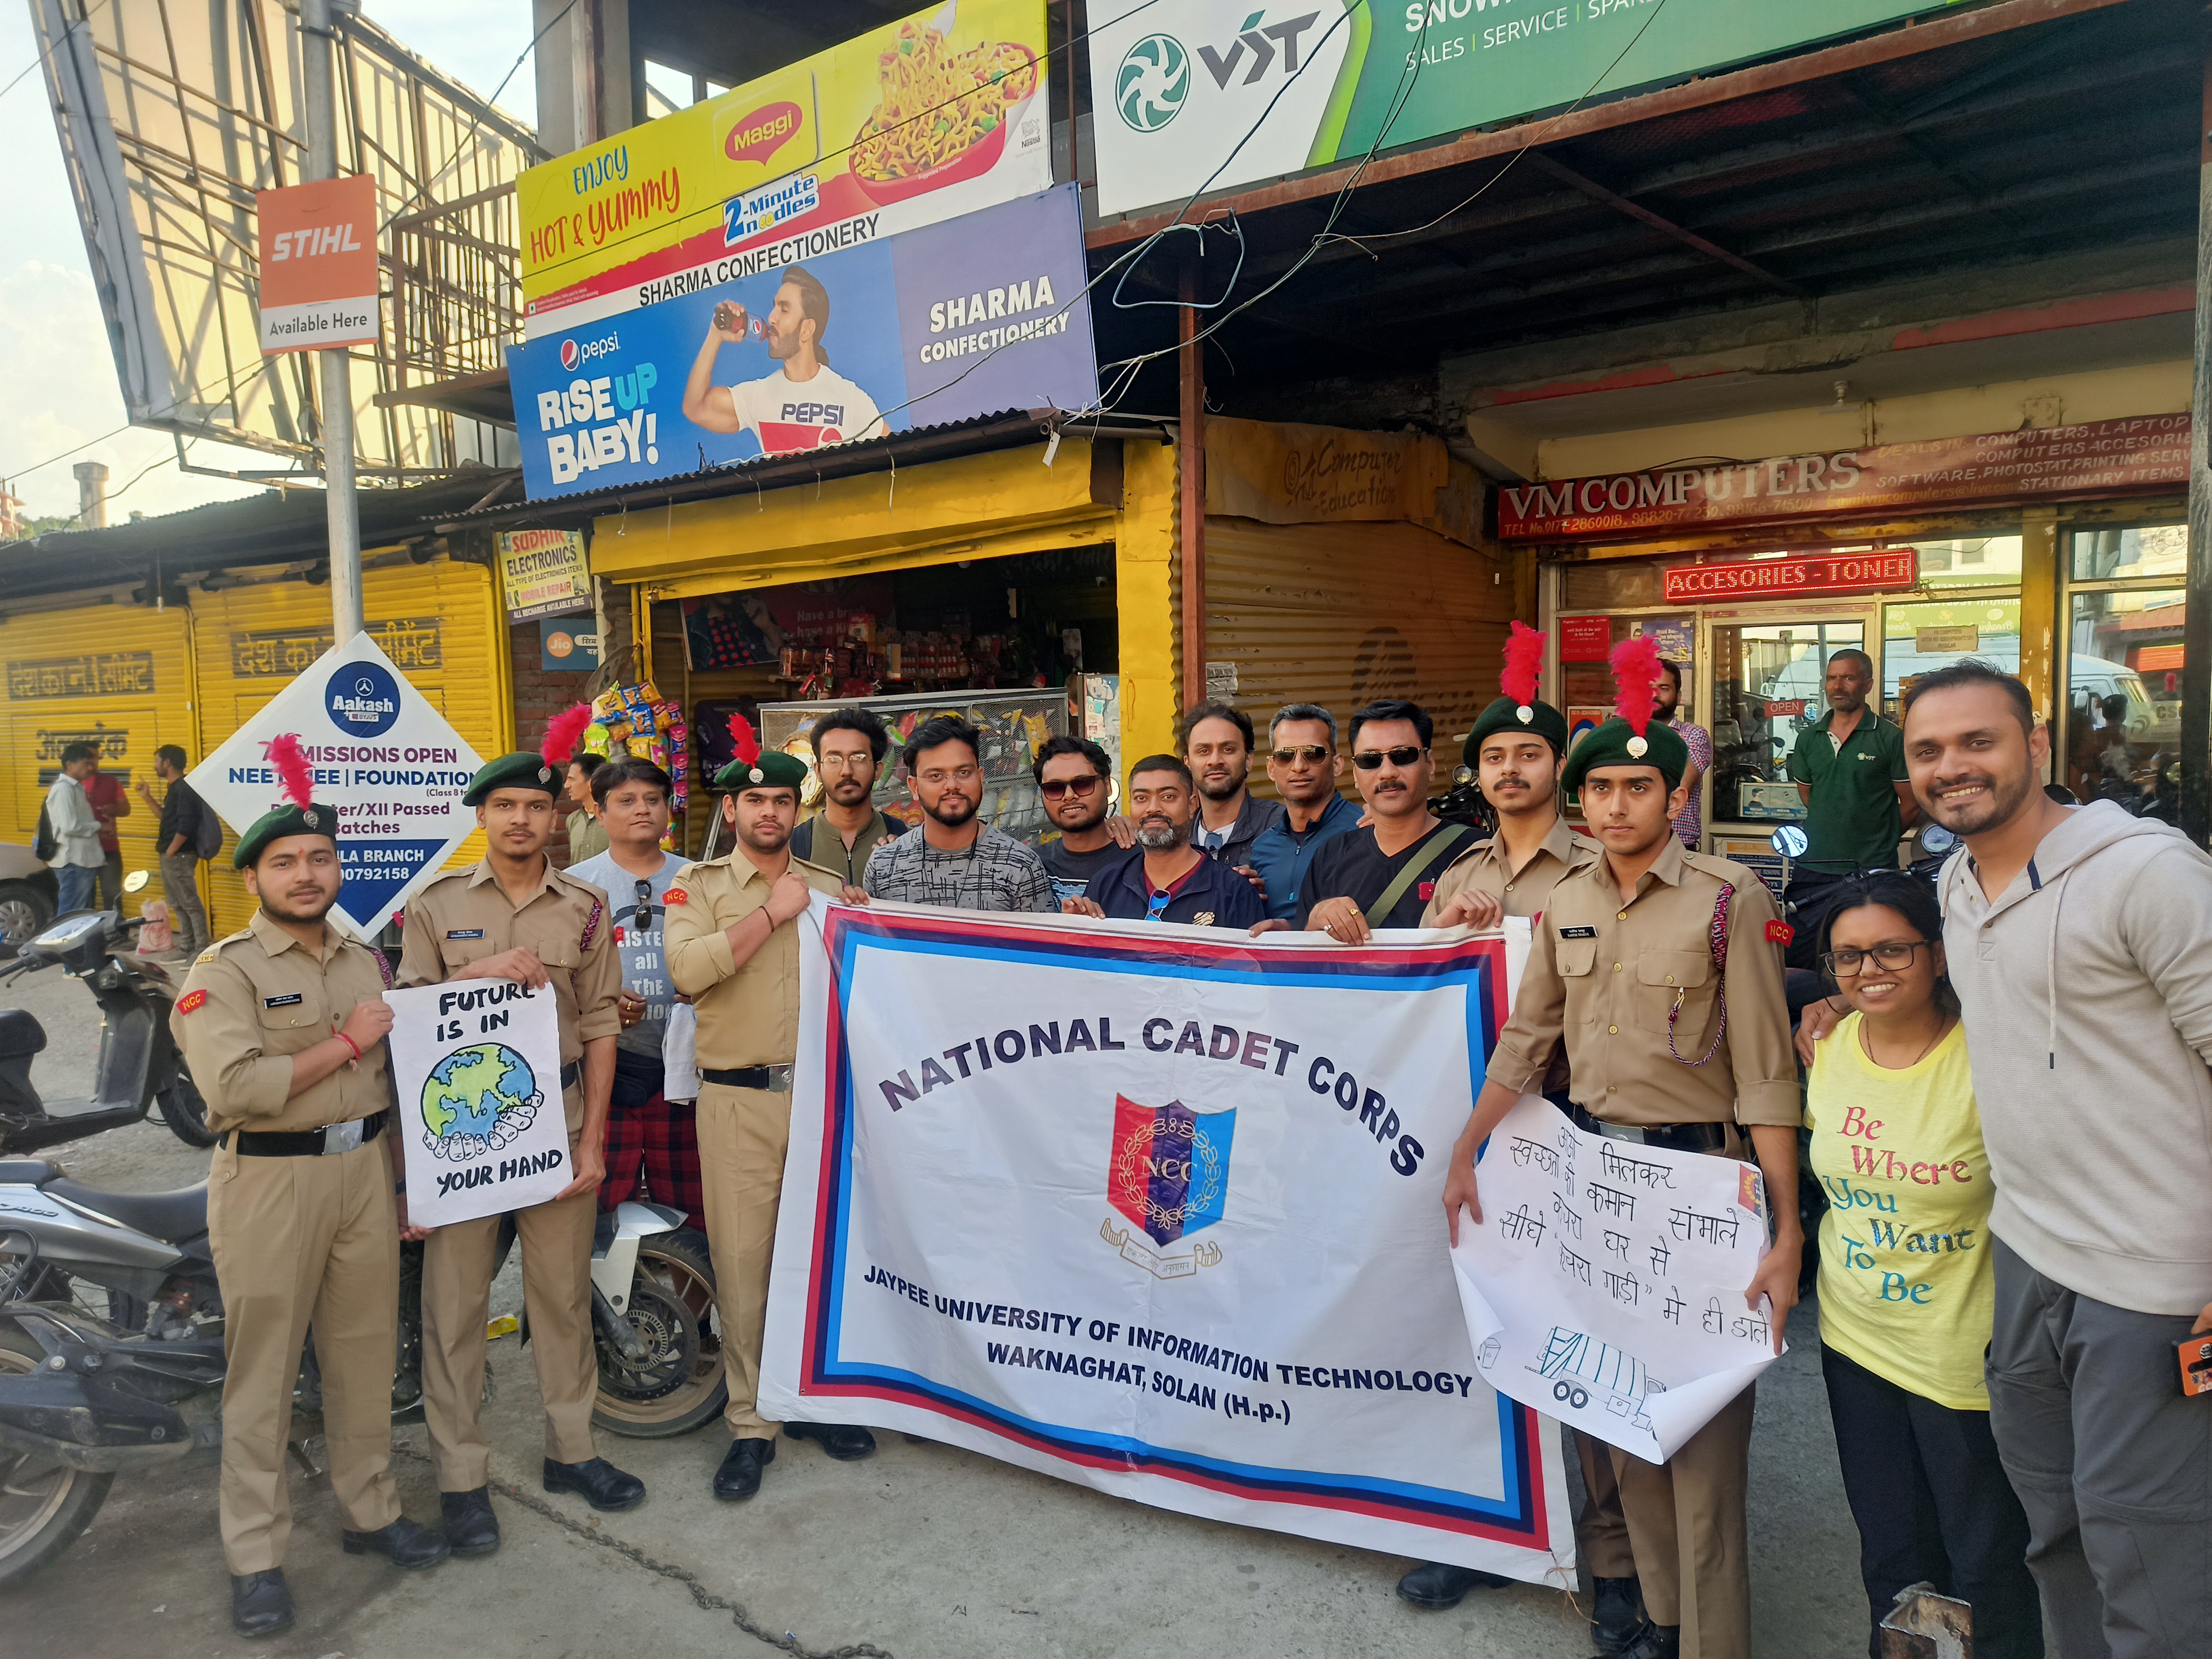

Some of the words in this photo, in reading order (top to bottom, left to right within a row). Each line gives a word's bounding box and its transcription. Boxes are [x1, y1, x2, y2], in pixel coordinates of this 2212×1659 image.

[1197, 9, 1321, 91] VST
[1406, 37, 1464, 71] SALES
[1483, 6, 1568, 48] SERVICE
[734, 110, 792, 152] Maggi
[573, 145, 628, 195] ENJOY
[918, 168, 938, 180] Suggested
[939, 156, 962, 173] Preparation
[272, 223, 361, 261] STIHL
[531, 215, 567, 264] HOT
[573, 213, 584, 246] &
[640, 268, 712, 306] SHARMA
[717, 213, 879, 282] CONFECTIONERY
[930, 276, 1055, 333] SHARMA
[270, 314, 327, 335] Available
[333, 312, 368, 329] Here
[920, 312, 1070, 363] CONFECTIONERY
[581, 331, 619, 363] pepsi
[538, 376, 615, 431] RISE
[614, 362, 658, 410] UP
[781, 402, 844, 426] PEPSI
[547, 408, 659, 484] BABY!
[1878, 440, 1941, 458] DEALS
[1976, 426, 2094, 448] COMPUTERS,
[1976, 440, 2085, 463] COMPUTERS
[2089, 432, 2192, 452] ACCESORIE
[2150, 448, 2191, 464] SERV
[1505, 482, 1575, 520] VM
[1581, 451, 1860, 513] COMPUTERS
[2020, 471, 2125, 491] STATIONARY
[2131, 466, 2184, 481] ITEMS
[1321, 475, 1395, 515] Education
[512, 529, 565, 553] SUDHIR
[1504, 524, 1525, 535] TEL
[507, 544, 577, 577] ELECTRONICS
[516, 577, 527, 585] TYPE
[535, 568, 566, 581] ELECTRONICS
[568, 564, 583, 574] ITEMS
[520, 586, 545, 602] MOBILE
[547, 581, 572, 595] REPAIR
[1669, 565, 1805, 592] ACCESORIES
[522, 605, 546, 616] RECHARGE
[547, 600, 571, 612] AVAILABLE
[571, 597, 585, 606] HERE
[797, 611, 824, 622] Have
[828, 611, 834, 619] a
[550, 638, 570, 649] Jio
[333, 695, 394, 712] Aakash
[1770, 702, 1799, 712] OPEN
[404, 747, 457, 763] OPEN
[394, 802, 450, 815] Passed
[427, 789, 452, 797] (Class
[363, 849, 424, 863] BRANCH
[667, 892, 685, 901] NCC
[1770, 925, 1789, 940] NCC
[635, 953, 658, 970] all
[182, 994, 201, 1010] NCC
[437, 1021, 463, 1042] IS
[481, 1010, 508, 1033] IN
[879, 1017, 1125, 1112] NATIONAL
[1142, 1018, 1299, 1076] CADET
[1308, 1056, 1424, 1177] CORPS
[1836, 1106, 1885, 1140] Be
[437, 1165, 493, 1198] YOUR
[499, 1150, 563, 1182] HAND
[1141, 1156, 1198, 1182] NCC
[1600, 1142, 1676, 1189] मिलकर
[1851, 1145, 1972, 1185] Where
[1822, 1175, 1899, 1213] You
[1587, 1182, 1636, 1221] कमान
[1669, 1205, 1739, 1249] संभाले
[1868, 1217, 1976, 1253] Want
[1127, 1247, 1147, 1262] एकता
[1162, 1262, 1190, 1275] अनुशासन
[1604, 1229, 1630, 1262] घर
[1651, 1236, 1671, 1276] से
[1840, 1233, 1876, 1270] To
[1876, 1271, 1934, 1305] Be
[864, 1265, 930, 1308] JAYPEE
[935, 1294, 1082, 1336] UNIVERSITY
[1089, 1320, 1120, 1343] OF
[1128, 1326, 1268, 1382] INFORMATION
[1276, 1364, 1472, 1397] TECHNOLOGY
[1702, 1296, 1723, 1335] ही
[987, 1342, 1147, 1392] WAKNAGHAT,
[1152, 1370, 1216, 1410] SOLAN
